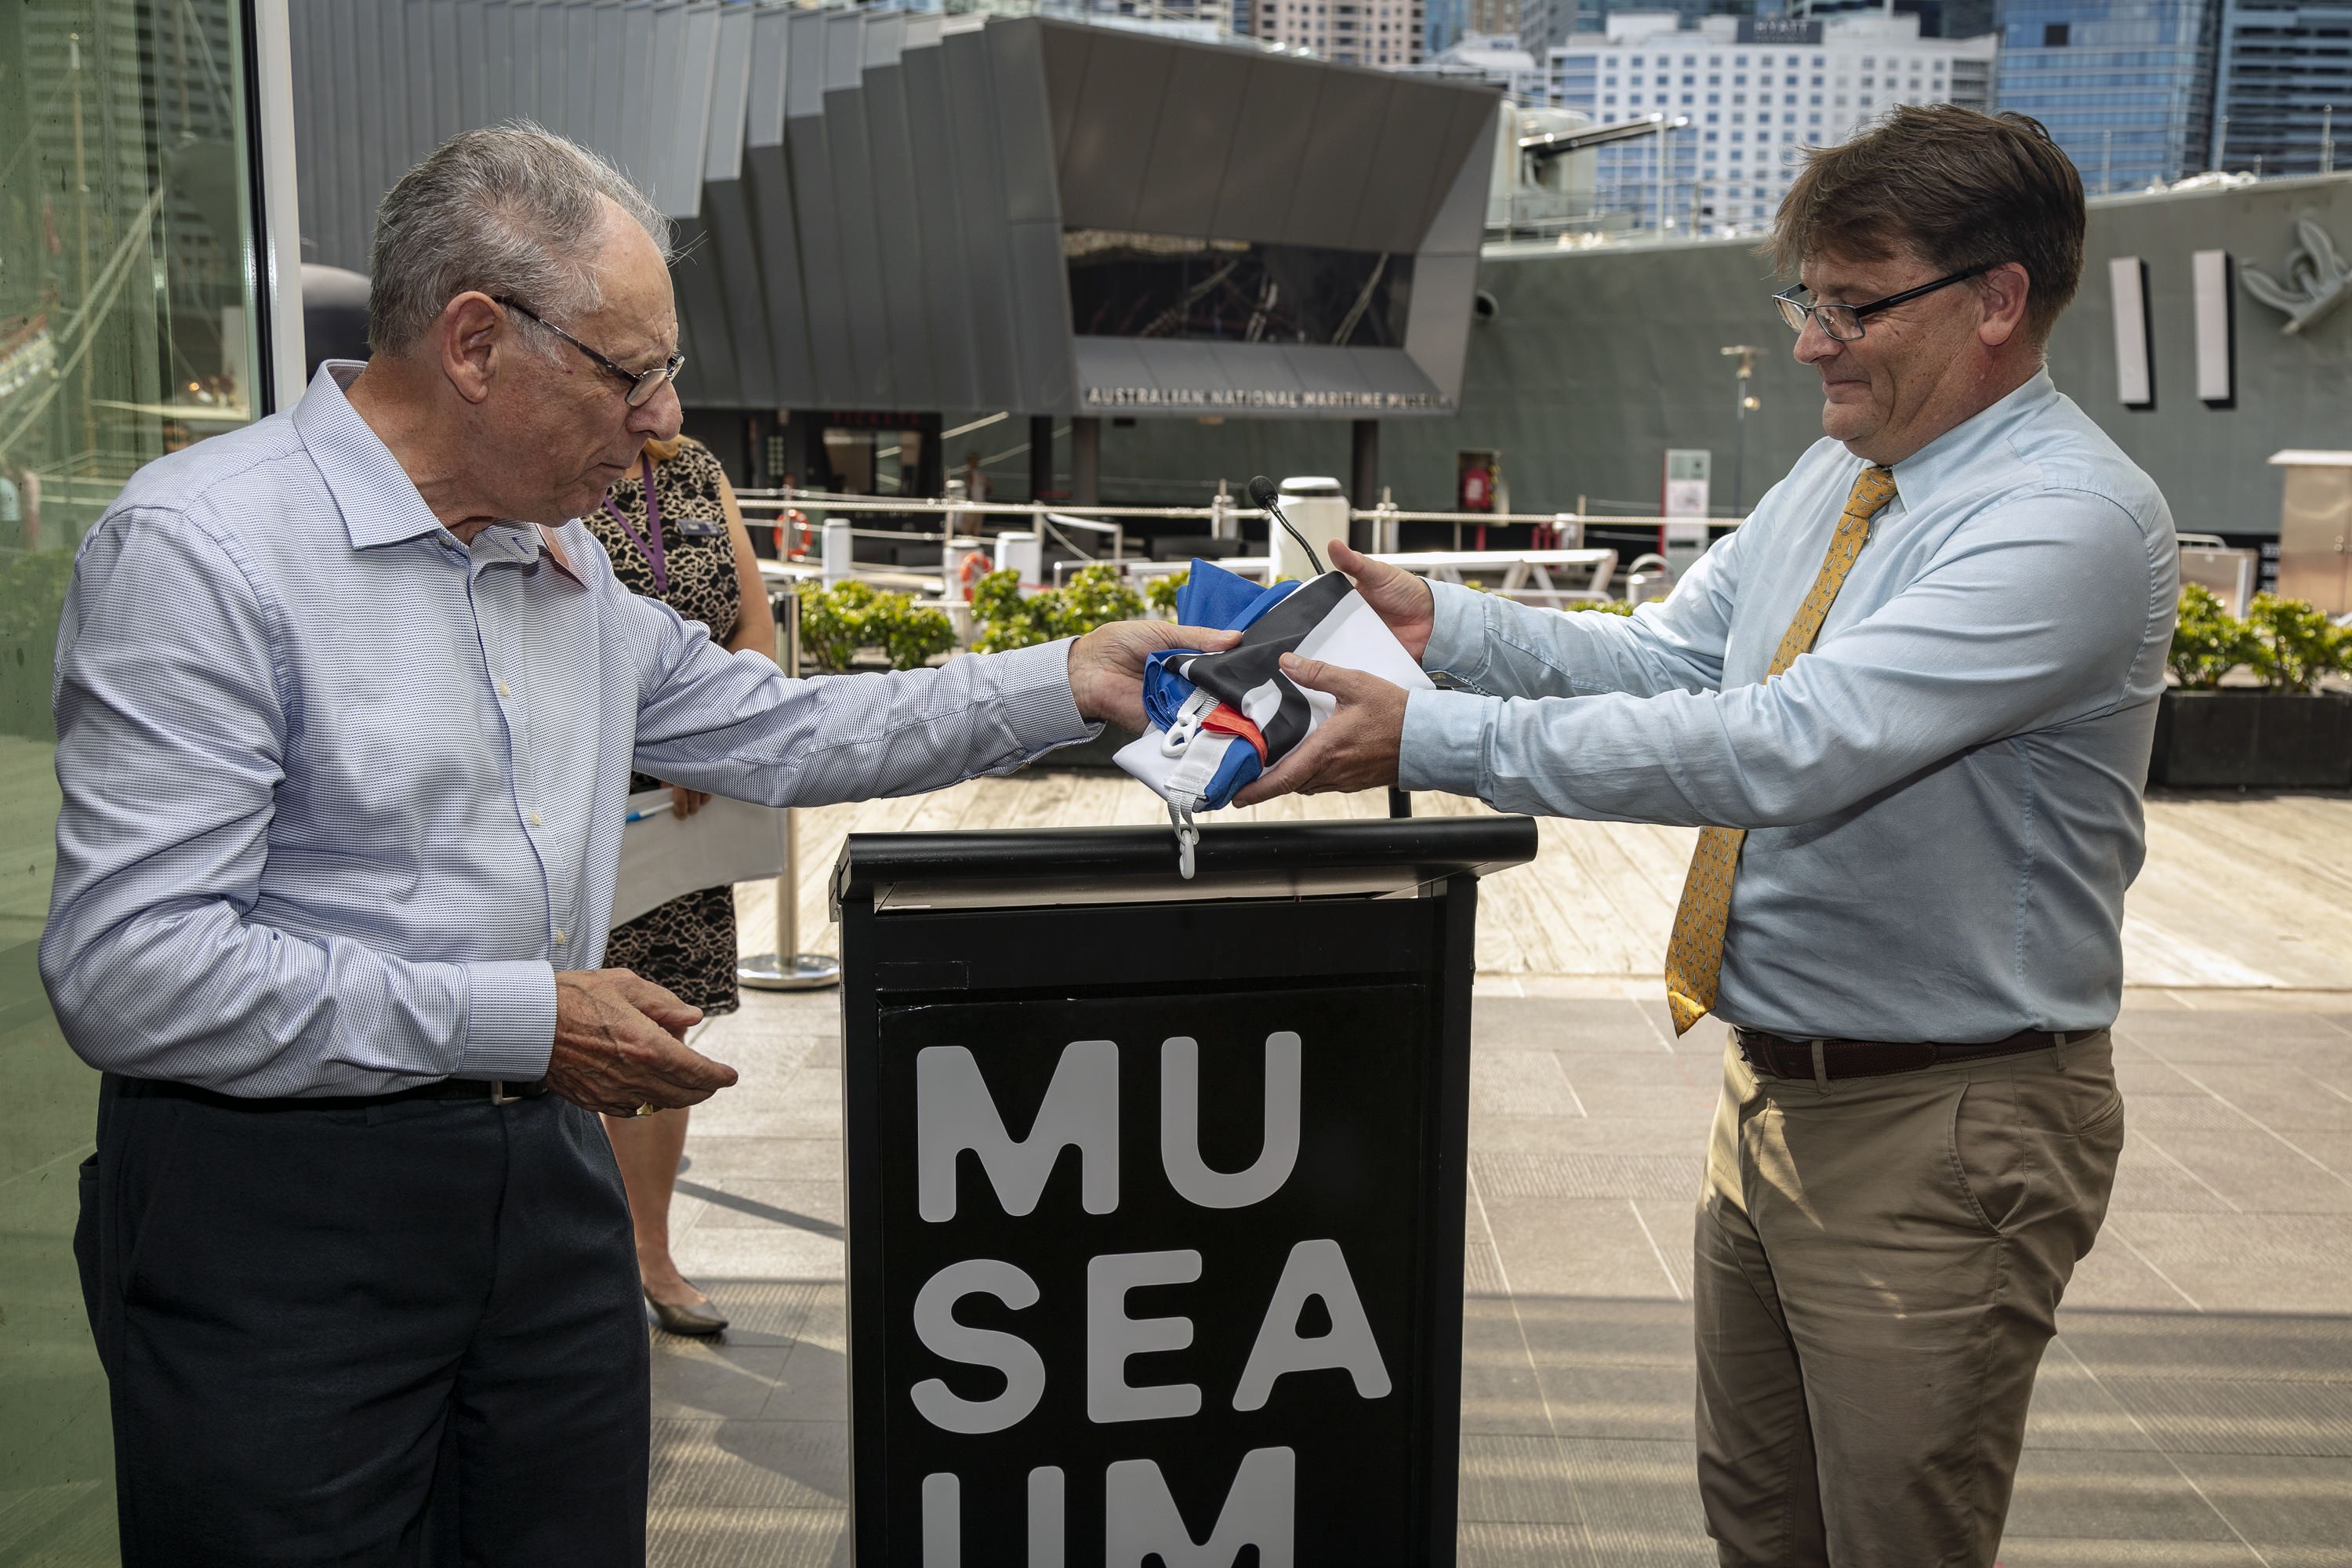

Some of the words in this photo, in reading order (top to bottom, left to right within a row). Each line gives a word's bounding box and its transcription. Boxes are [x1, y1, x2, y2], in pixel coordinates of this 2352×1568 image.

[1088, 387, 1204, 405] AUSTRALIAN
[1210, 390, 1297, 408] NATIONAL
[1302, 391, 1381, 408] MARITIME
[917, 1032, 1301, 1222] MU
[910, 1239, 1392, 1434] SEA
